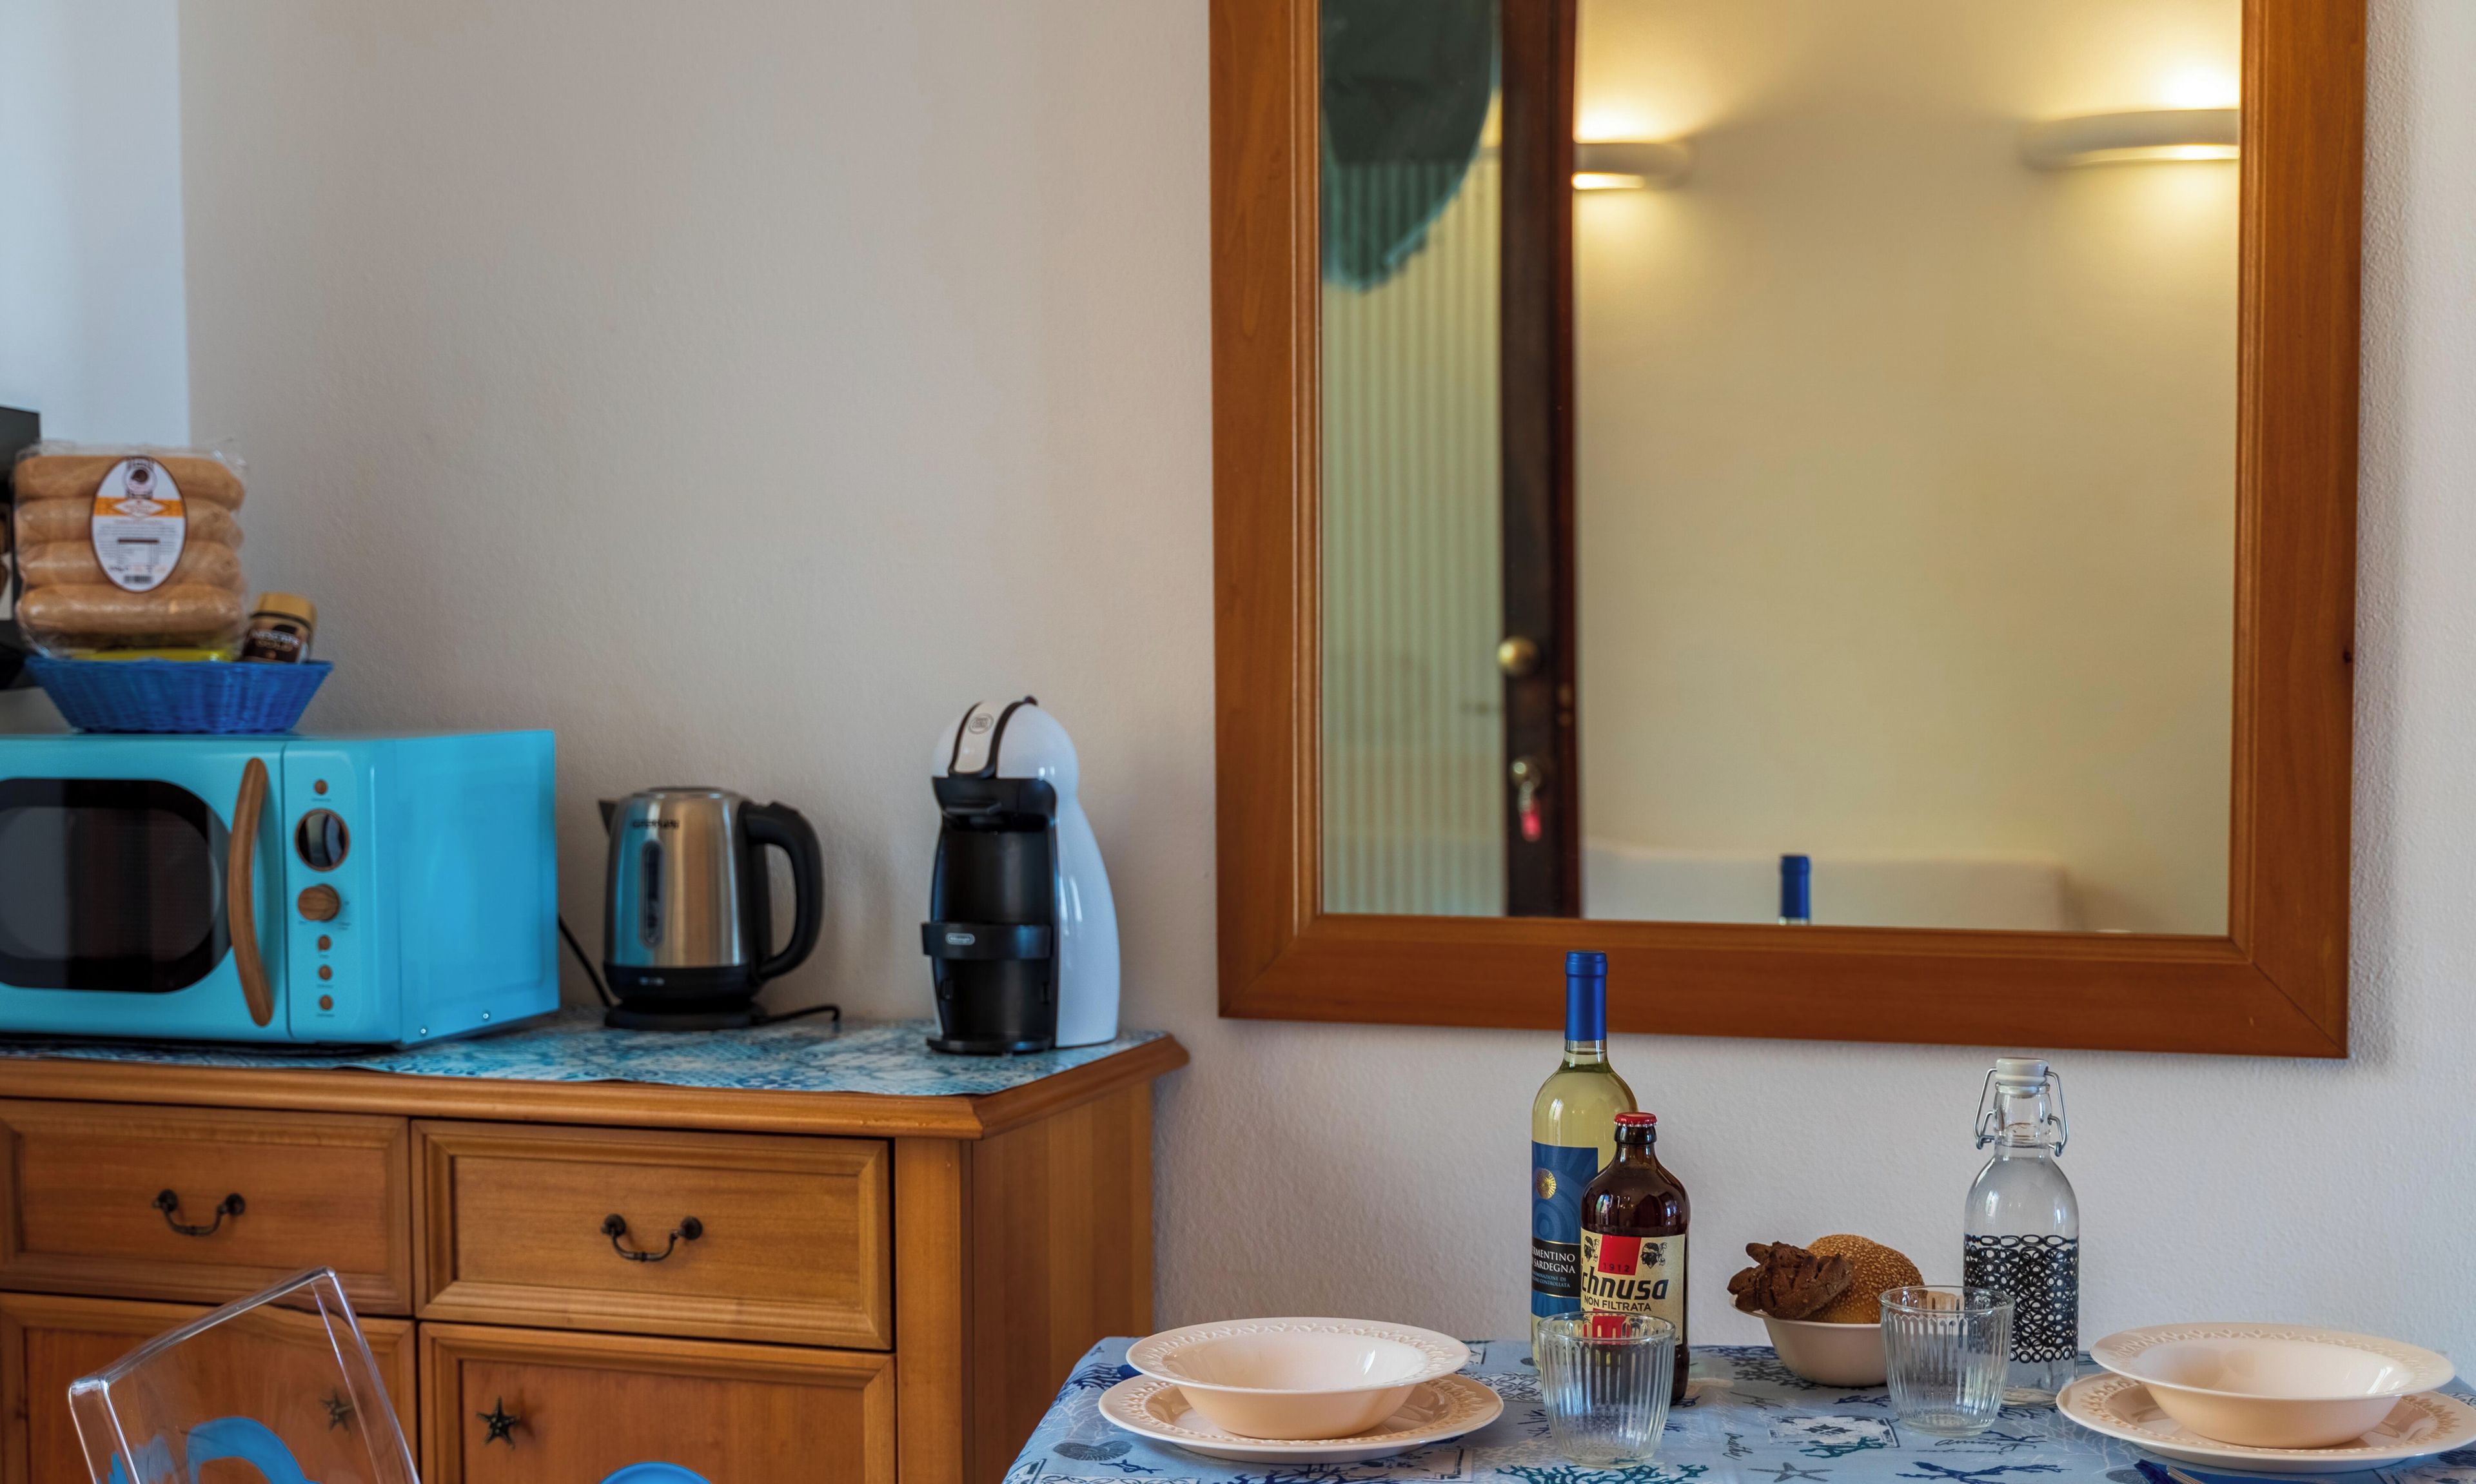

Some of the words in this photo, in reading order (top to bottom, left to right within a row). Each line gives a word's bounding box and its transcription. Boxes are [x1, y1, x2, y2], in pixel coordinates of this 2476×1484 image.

[1532, 1245, 1575, 1262] RMENTINO
[1534, 1258, 1576, 1274] SARDEGNA
[1603, 1262, 1631, 1273] 1912
[1539, 1278, 1571, 1288] CONTROLLATA
[1581, 1264, 1669, 1301] chnusa
[1584, 1294, 1600, 1307] NON
[1602, 1300, 1652, 1311] FILTRATA
